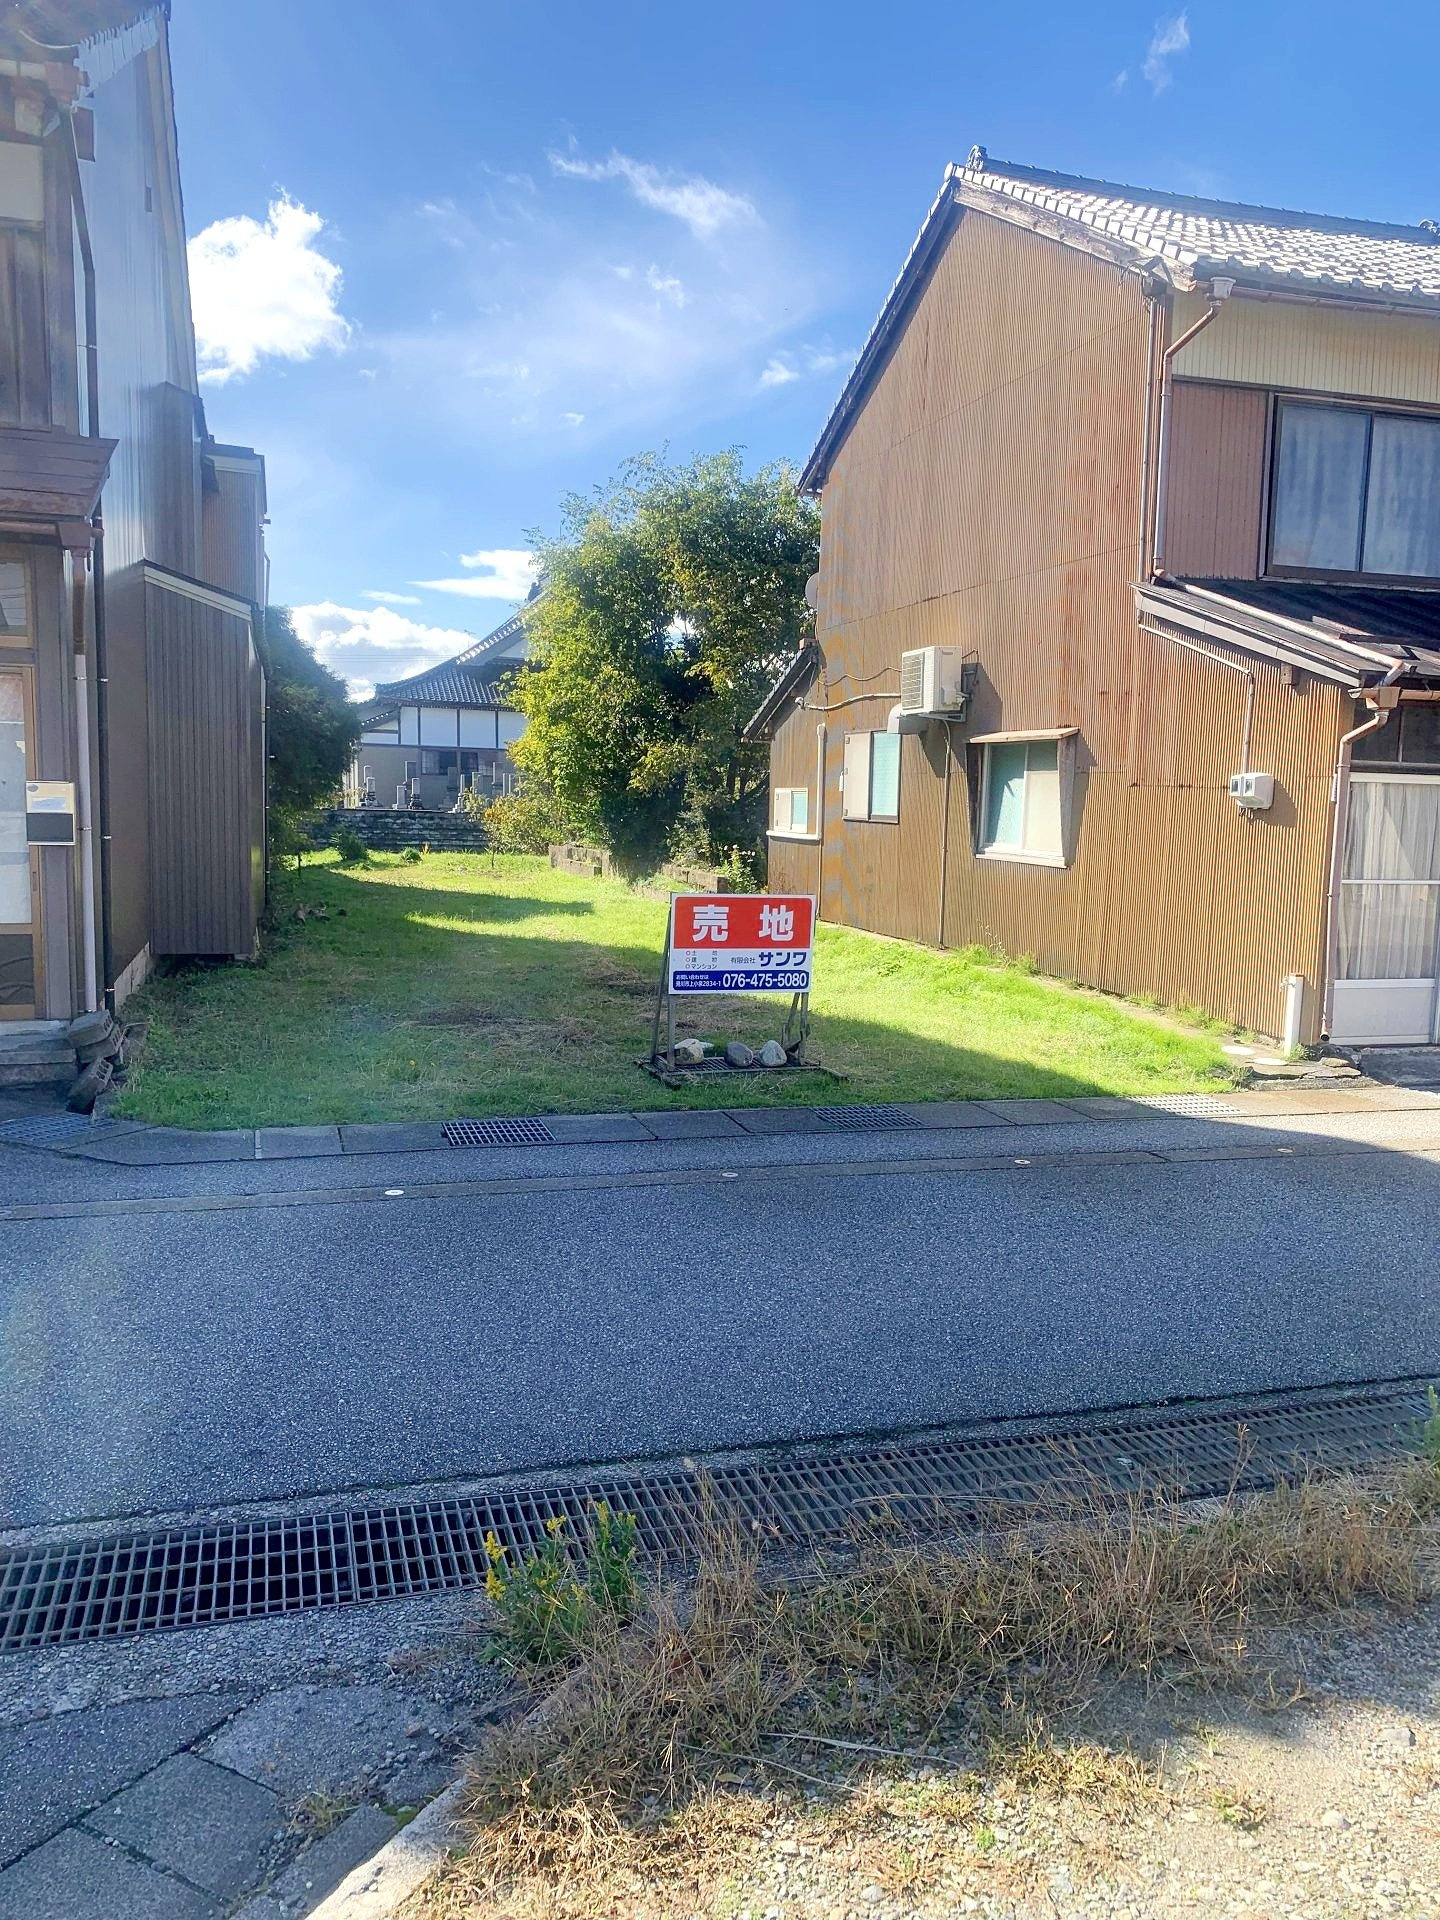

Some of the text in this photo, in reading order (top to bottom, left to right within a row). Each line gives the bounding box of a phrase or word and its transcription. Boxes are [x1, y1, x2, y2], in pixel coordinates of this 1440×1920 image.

[692, 904, 794, 942] 売地
[758, 951, 807, 967] サンワ
[722, 972, 807, 988] 076-475-5080
